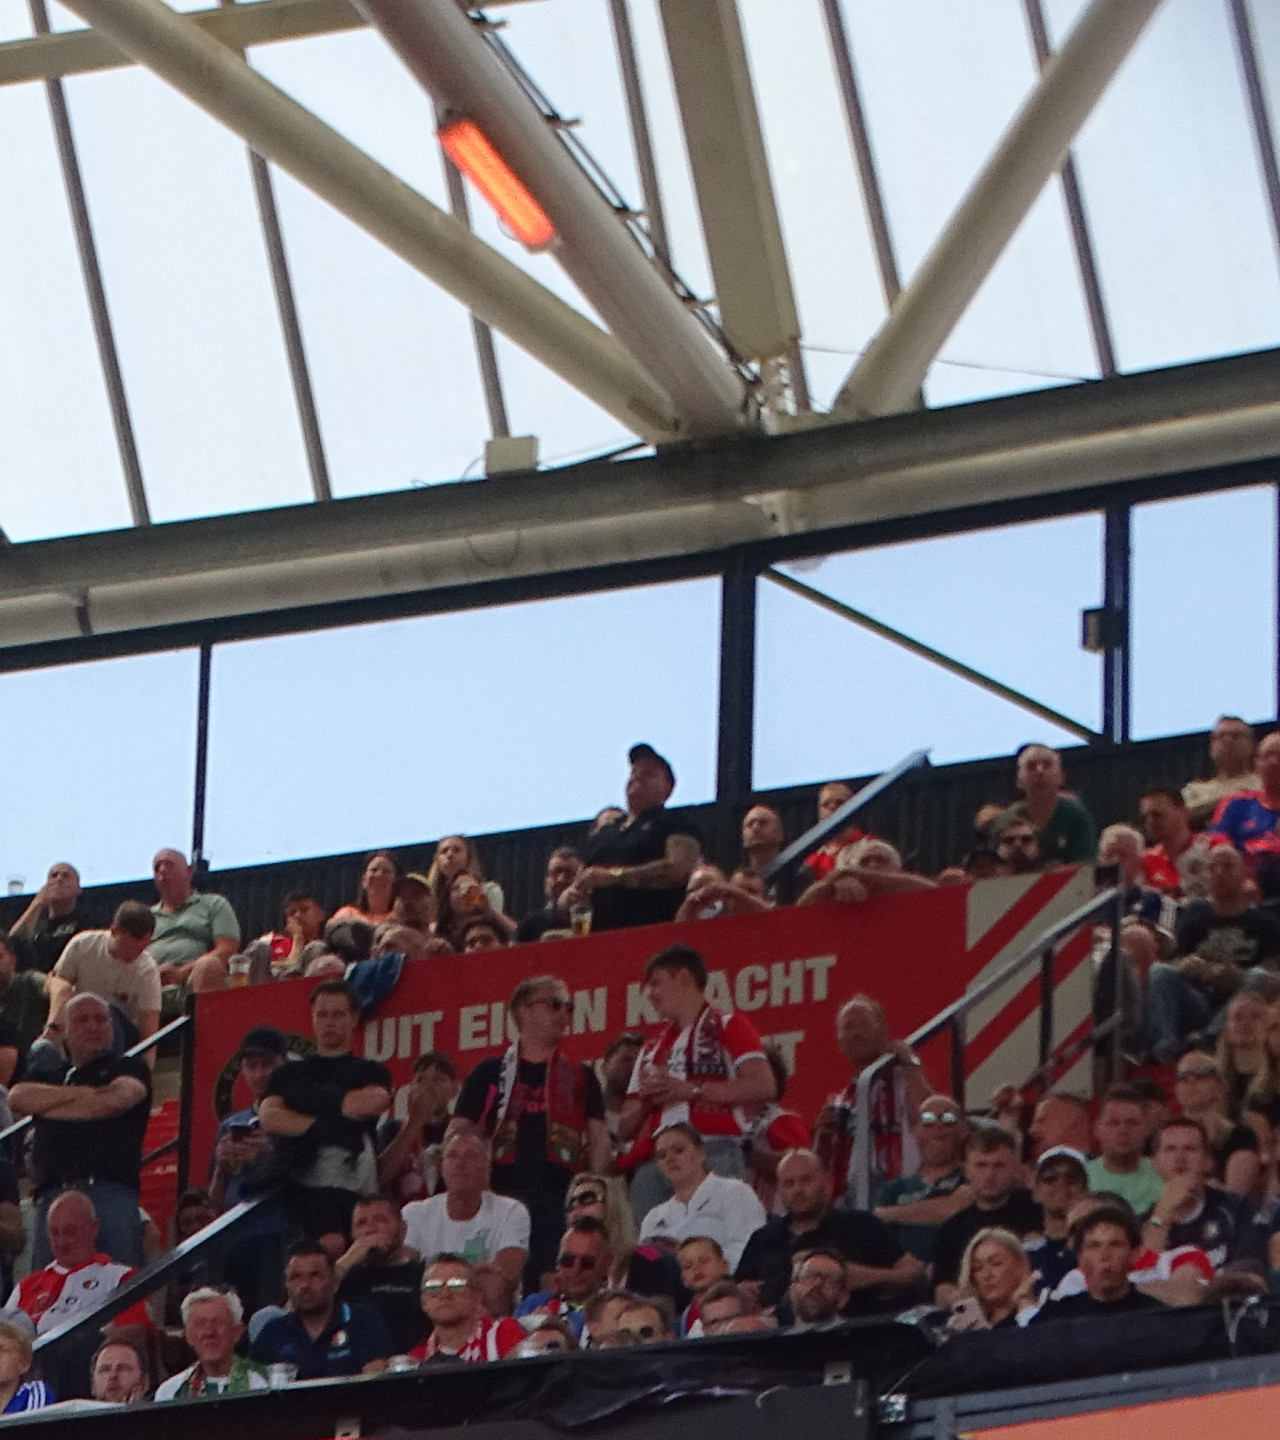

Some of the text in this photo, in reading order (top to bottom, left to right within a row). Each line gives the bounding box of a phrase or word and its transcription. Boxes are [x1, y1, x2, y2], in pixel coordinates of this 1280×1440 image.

[364, 1011, 443, 1063] UIT
[458, 987, 608, 1050] EIN
[626, 954, 837, 1027] KACHT
